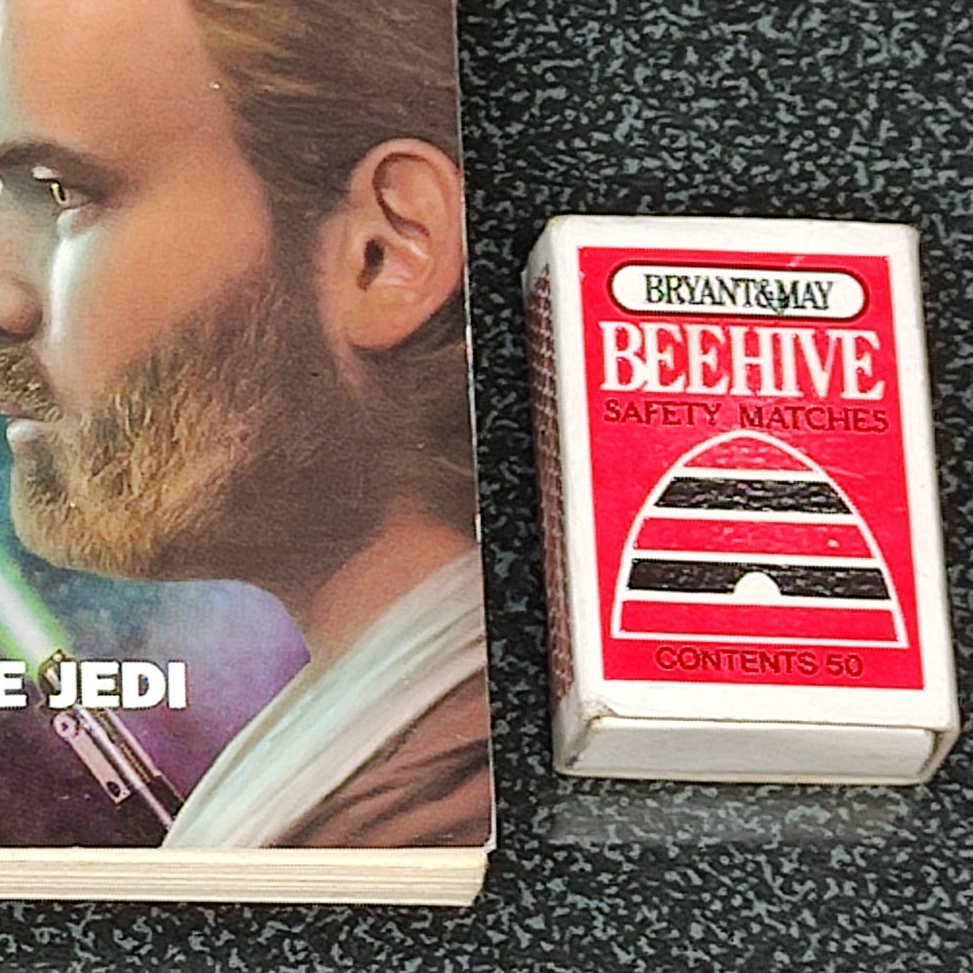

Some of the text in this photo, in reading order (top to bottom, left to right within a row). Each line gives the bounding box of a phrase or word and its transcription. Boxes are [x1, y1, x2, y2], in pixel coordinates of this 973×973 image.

[598, 320, 886, 401] BEEHIVE
[602, 399, 889, 433] SAFETY MATCHES
[655, 646, 864, 678] CONTENTS 50
[45, 660, 188, 710] JEDI
